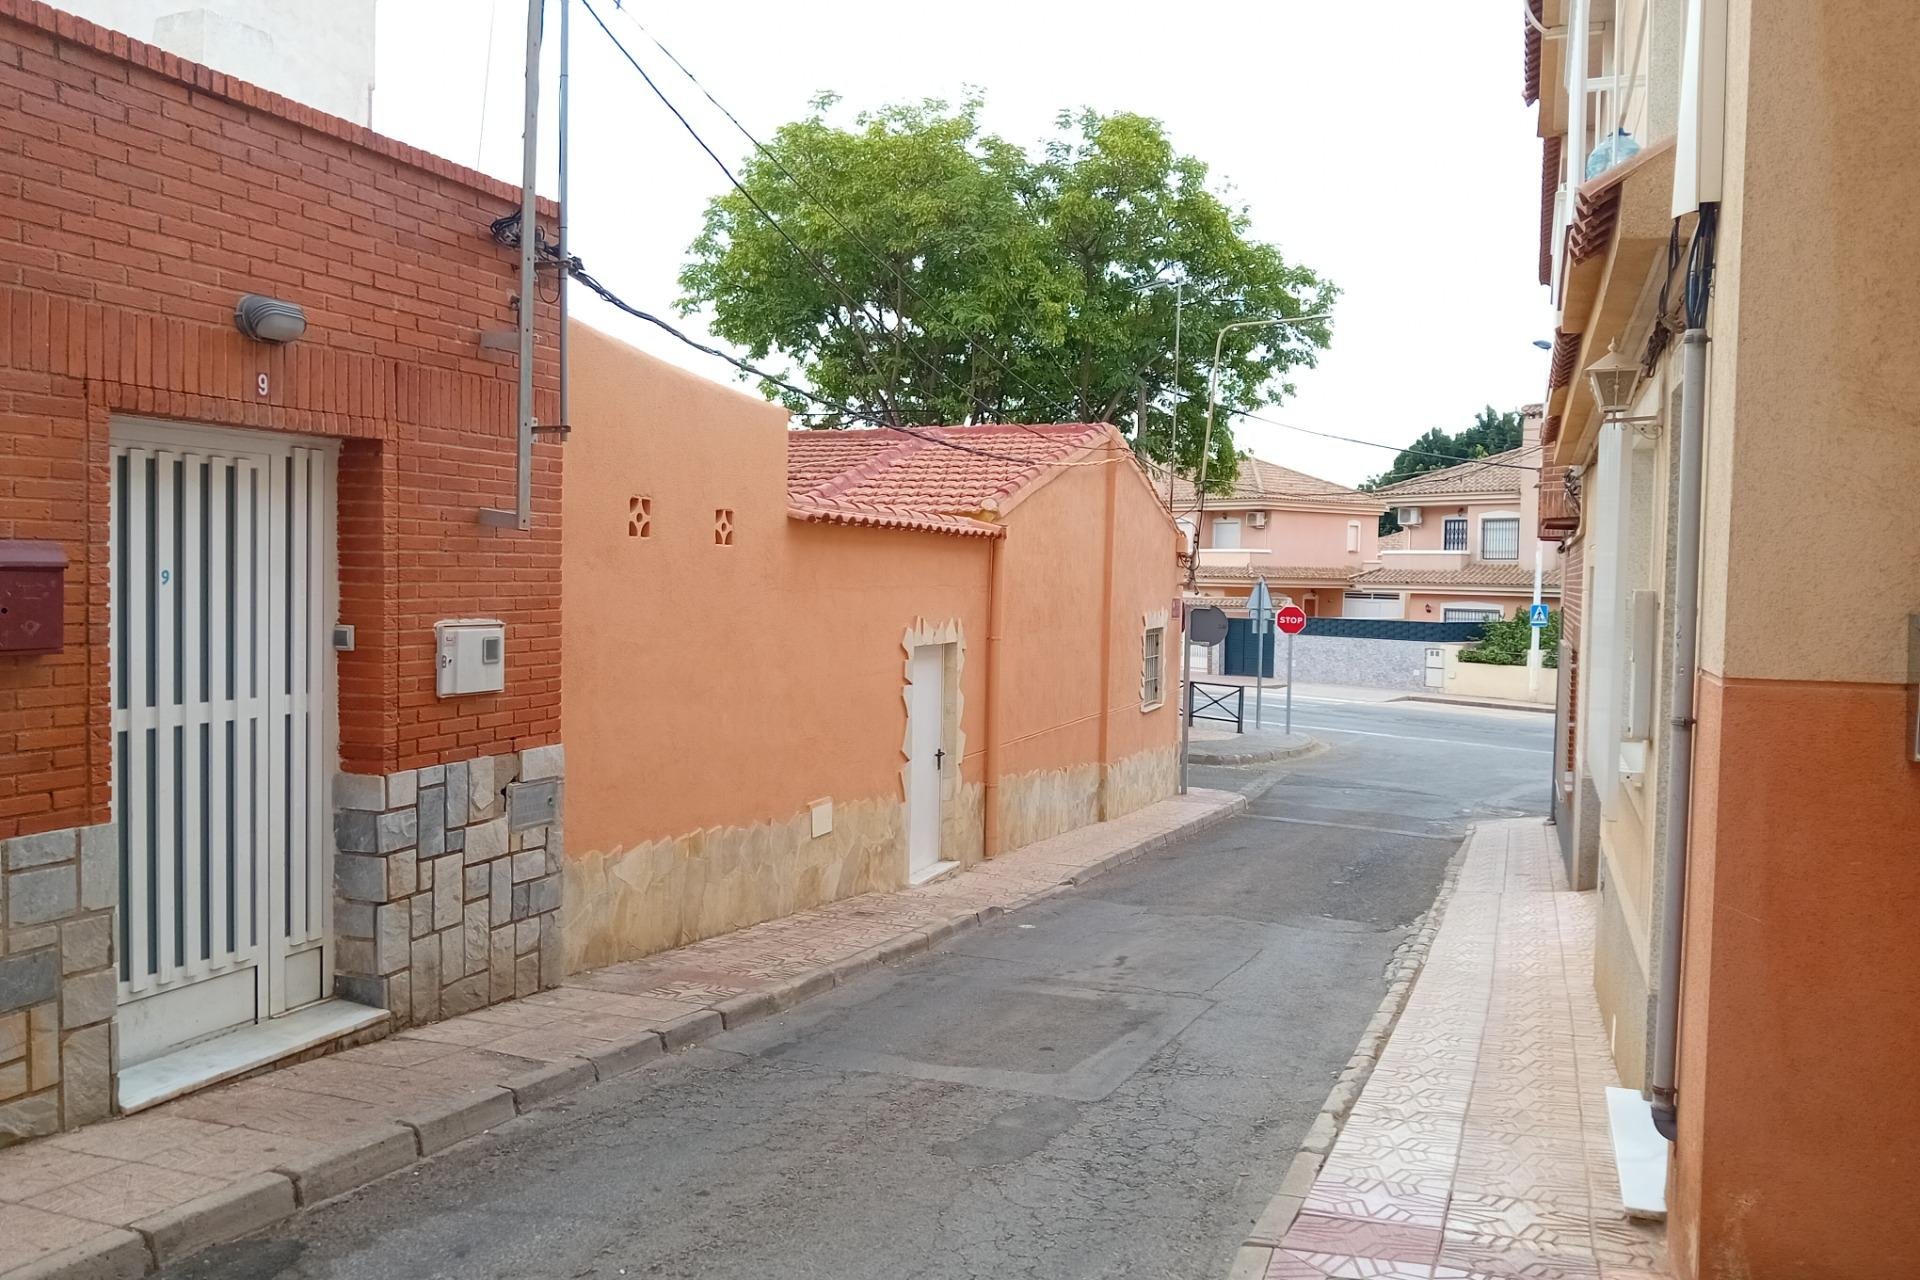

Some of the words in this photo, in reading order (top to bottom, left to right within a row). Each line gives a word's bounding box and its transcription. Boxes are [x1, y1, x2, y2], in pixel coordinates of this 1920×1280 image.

[258, 373, 268, 396] 9
[161, 569, 170, 585] 9
[1280, 616, 1303, 624] STOP
